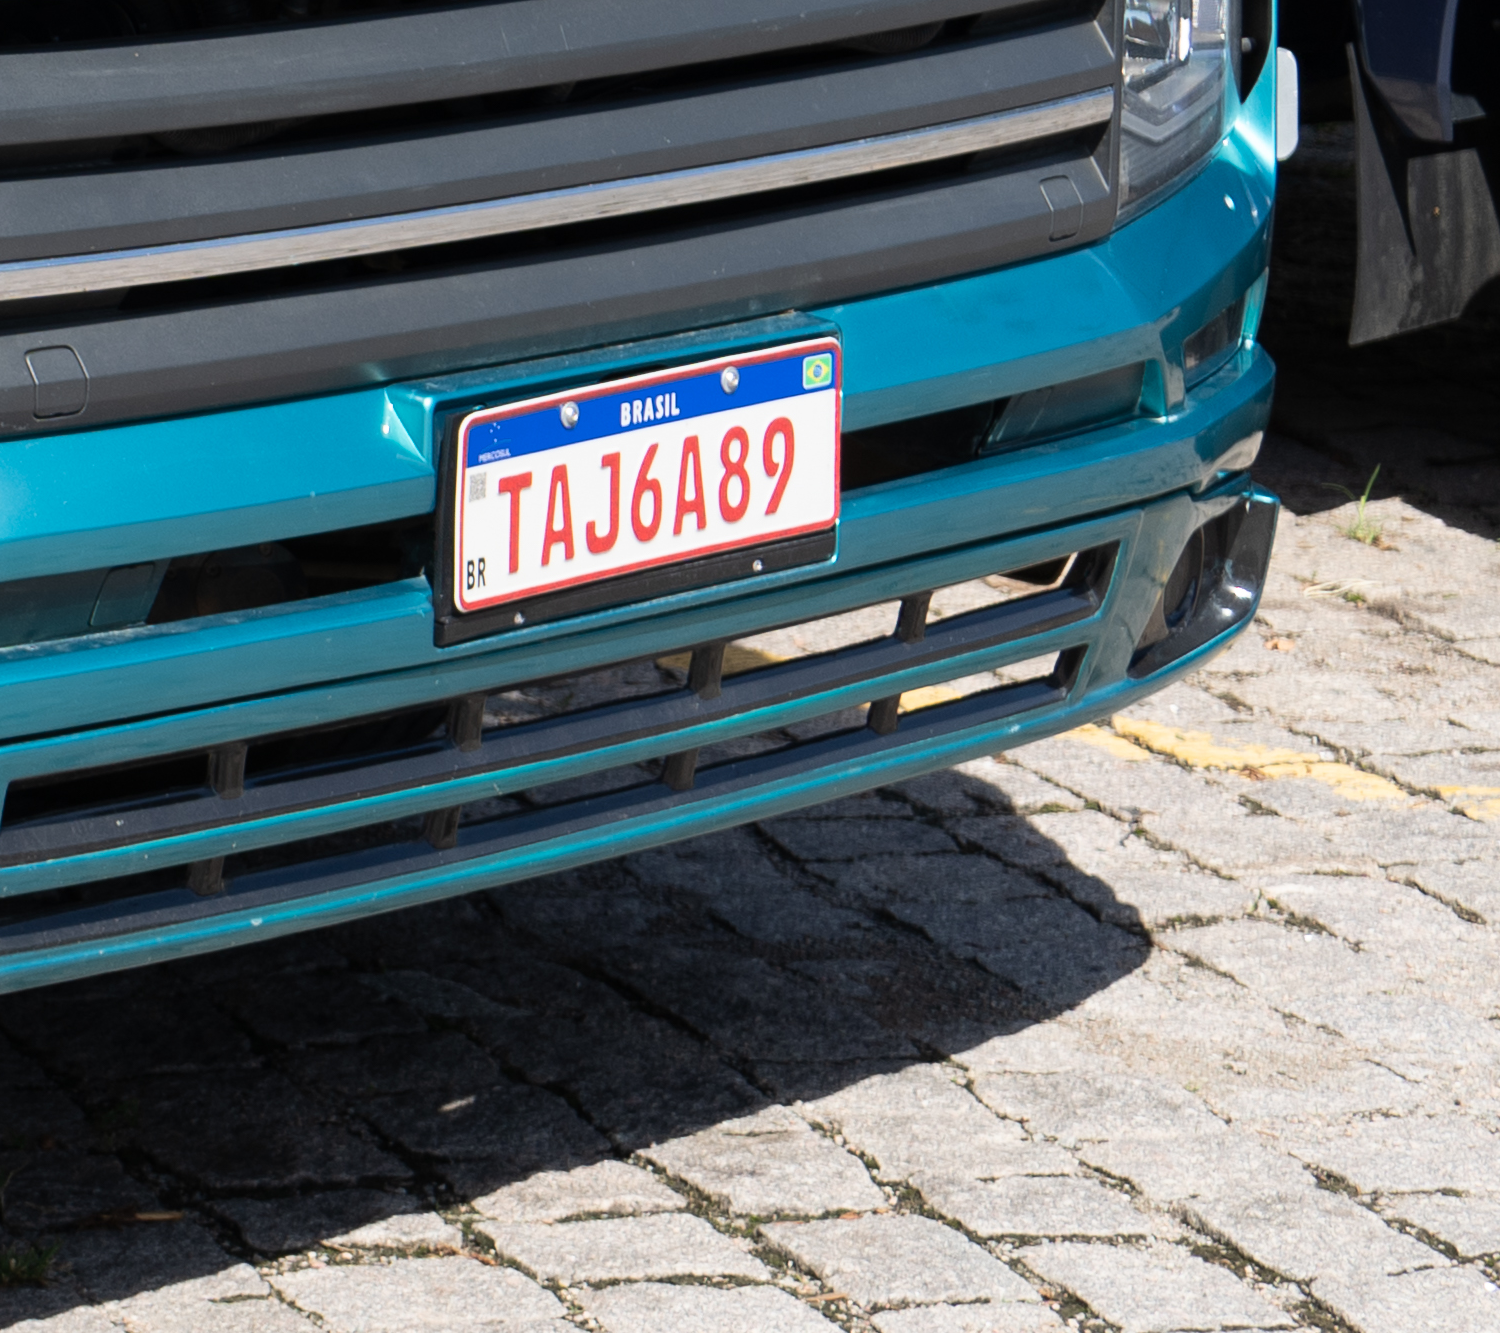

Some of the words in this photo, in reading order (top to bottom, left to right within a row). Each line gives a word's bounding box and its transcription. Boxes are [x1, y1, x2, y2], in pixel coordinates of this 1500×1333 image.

[620, 392, 681, 428] BRASIL
[498, 416, 796, 576] TAJ6A89
[466, 557, 487, 591] BR
